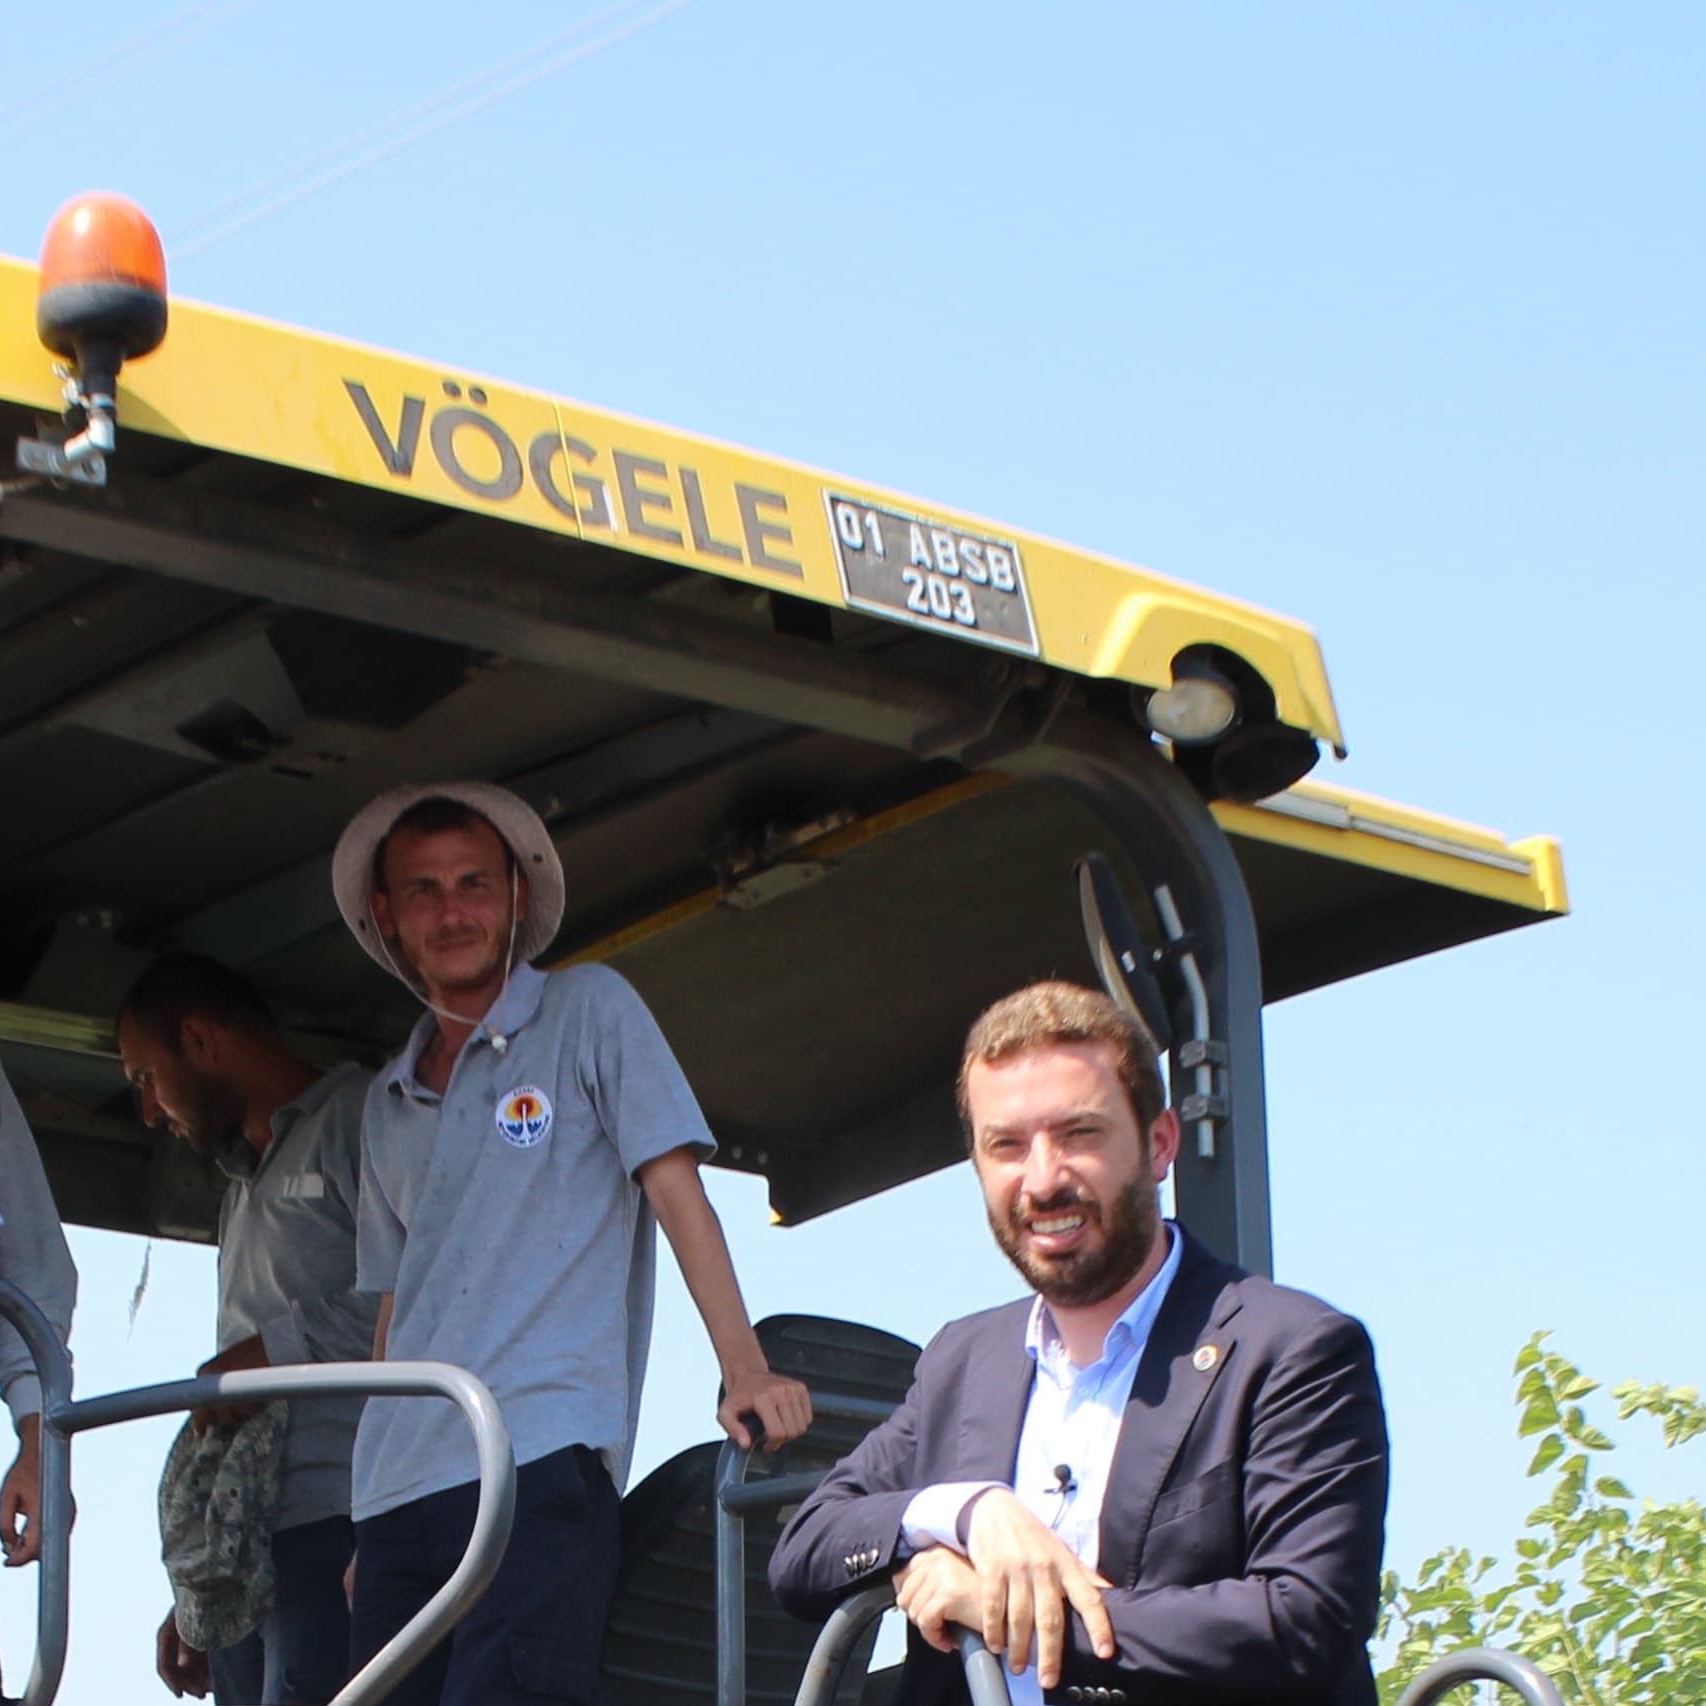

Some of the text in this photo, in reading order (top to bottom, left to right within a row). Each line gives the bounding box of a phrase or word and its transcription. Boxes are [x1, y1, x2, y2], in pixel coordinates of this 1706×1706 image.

[343, 379, 804, 582] VÖGELE
[837, 502, 1016, 592] 01 ABSB
[902, 565, 976, 626] 203
